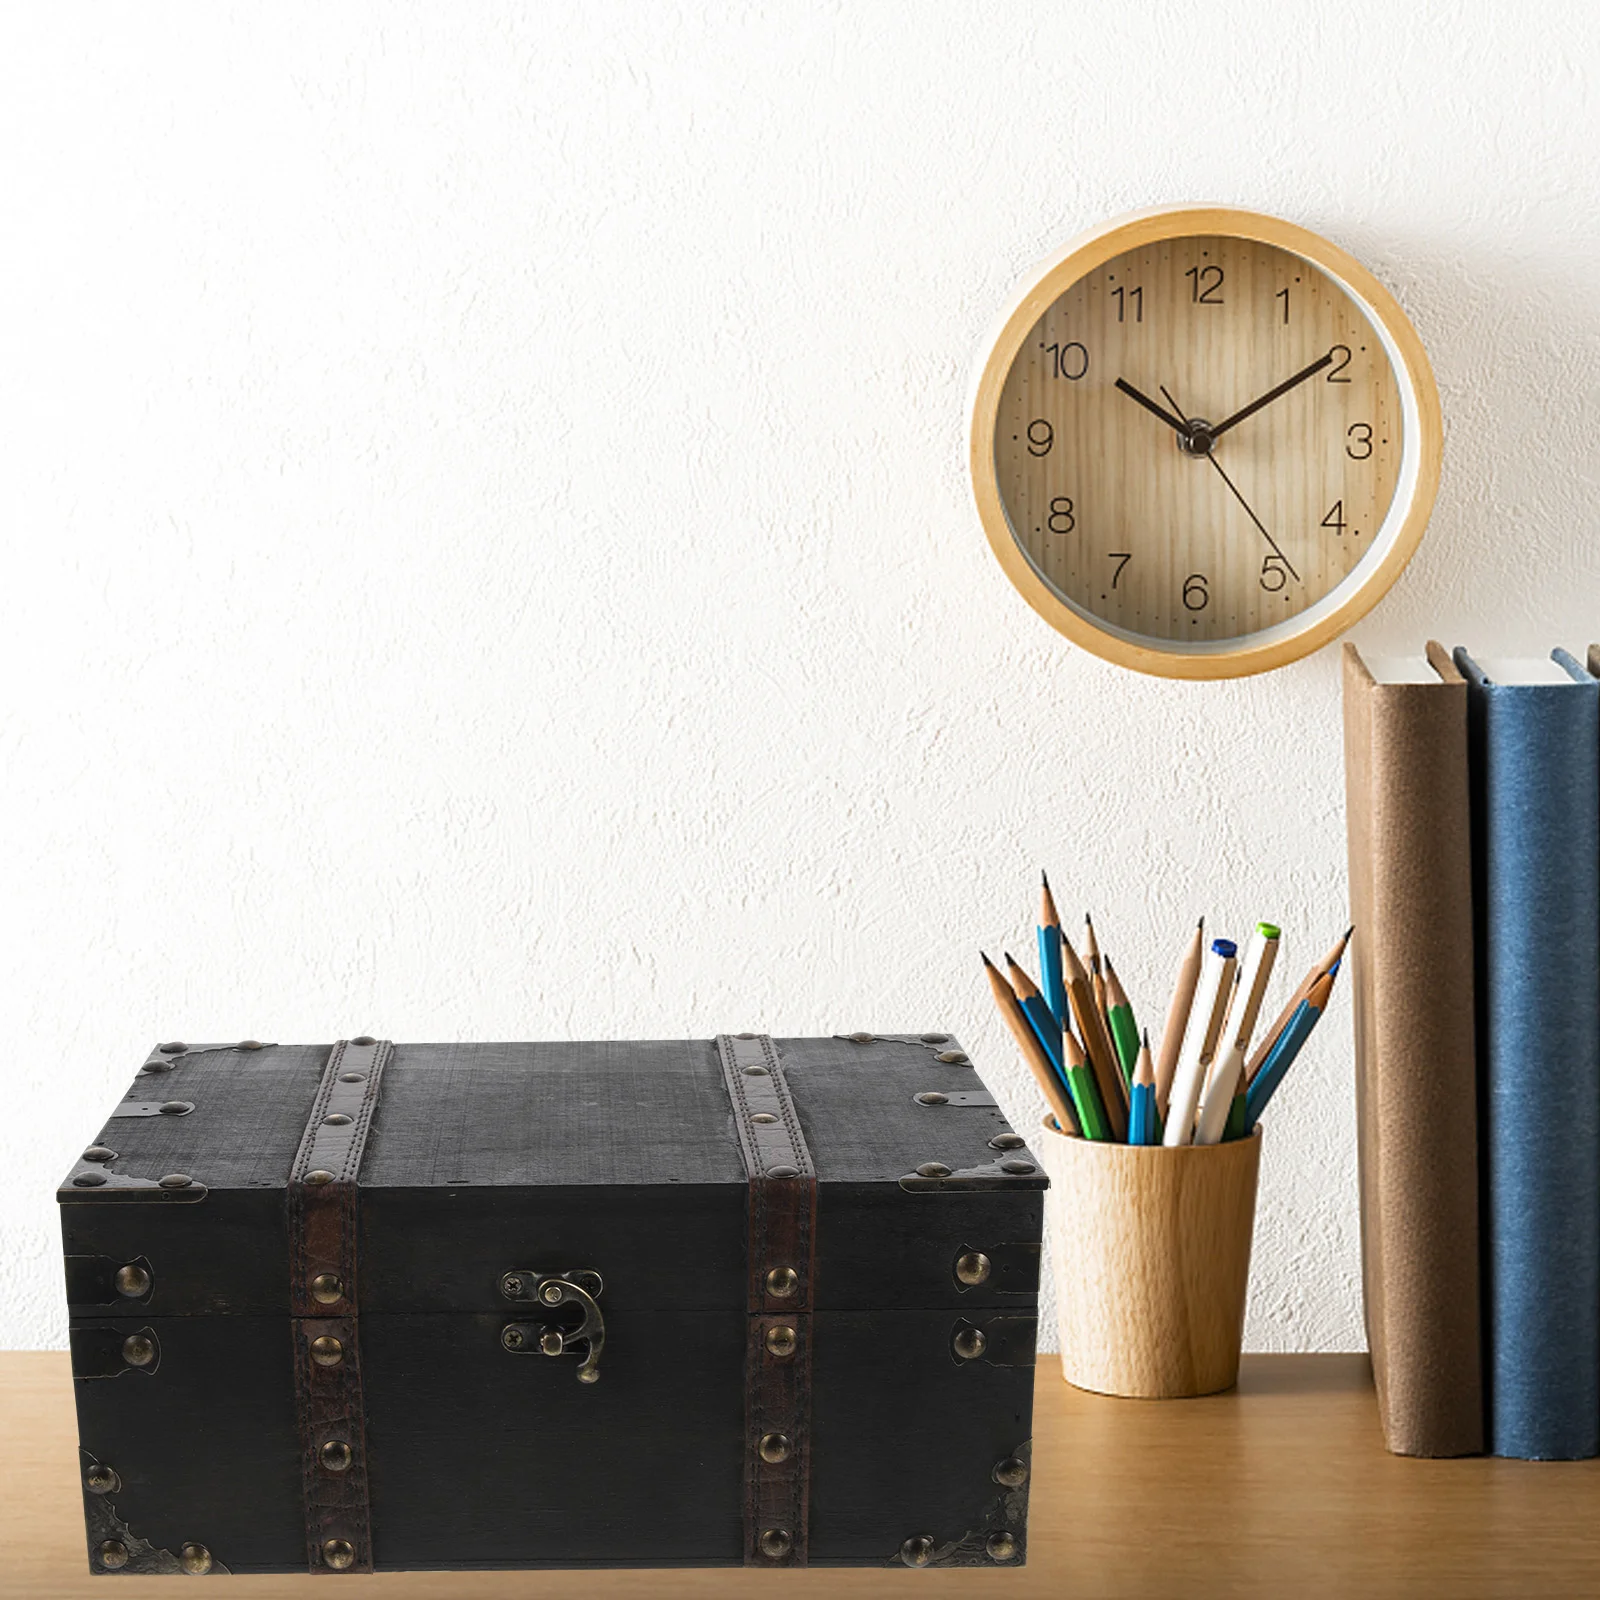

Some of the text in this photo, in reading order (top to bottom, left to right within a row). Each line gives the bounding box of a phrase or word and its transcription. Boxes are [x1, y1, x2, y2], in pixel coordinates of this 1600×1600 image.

[1185, 265, 1225, 304] 12
[1110, 286, 1143, 322] 11
[1275, 288, 1290, 325] 1
[1045, 342, 1089, 380] 10
[1326, 344, 1352, 383] 2
[1027, 419, 1054, 457] 9
[1345, 422, 1373, 460] 3
[1048, 497, 1075, 534] 8
[1320, 500, 1347, 536] 4
[1108, 553, 1132, 589] 7
[1259, 555, 1287, 592] 5
[1182, 574, 1209, 611] 6
